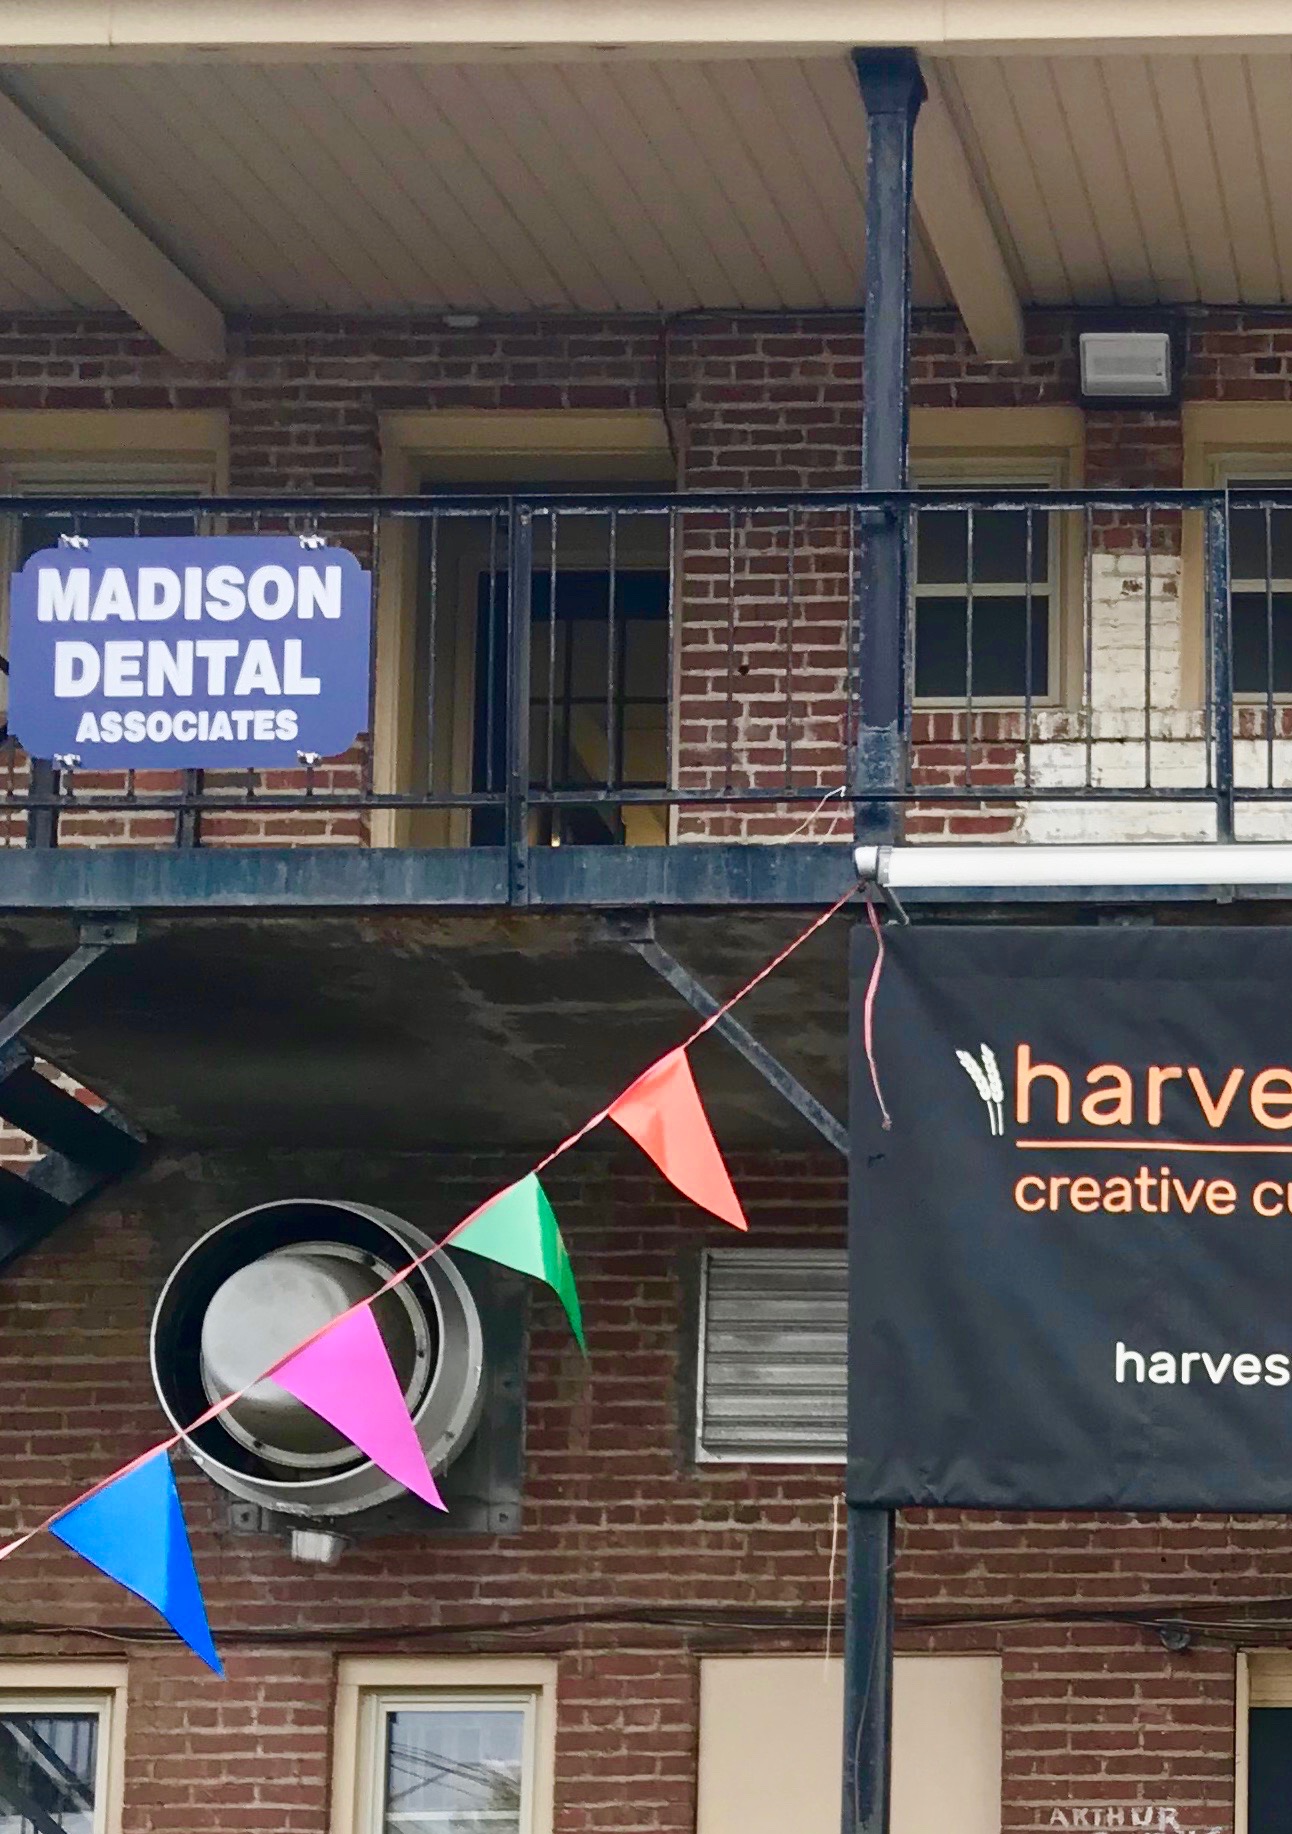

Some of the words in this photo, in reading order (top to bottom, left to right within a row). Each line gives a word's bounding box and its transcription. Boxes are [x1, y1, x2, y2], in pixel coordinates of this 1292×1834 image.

[37, 565, 342, 622] MADISON
[54, 639, 321, 697] DENTAL
[76, 709, 299, 743] ASSOCIATES
[1014, 1166, 1237, 1215] creative
